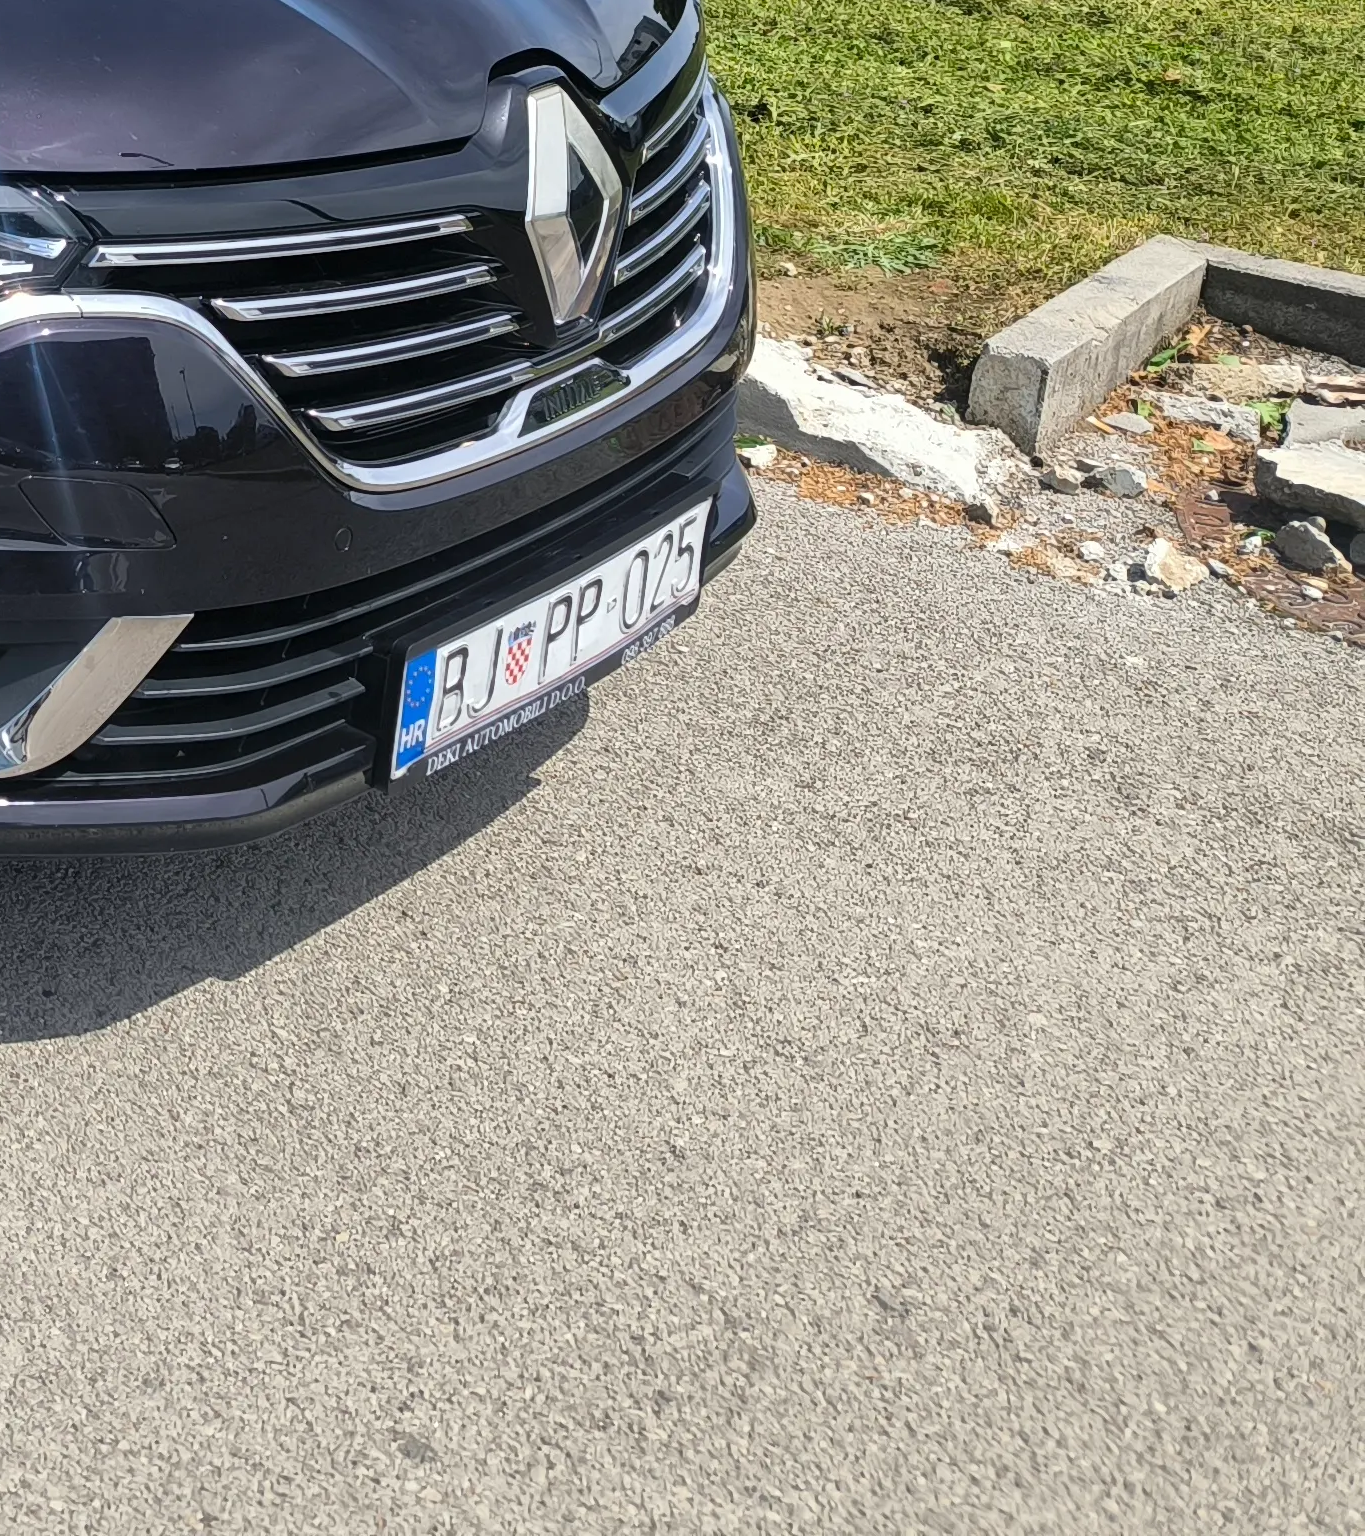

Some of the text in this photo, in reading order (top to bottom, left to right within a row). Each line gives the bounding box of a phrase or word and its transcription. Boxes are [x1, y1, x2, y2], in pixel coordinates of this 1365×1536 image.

[431, 622, 505, 740] BJ
[399, 718, 426, 754] HR
[425, 742, 462, 777] DEKI
[461, 695, 549, 758] AUTOMOBILI
